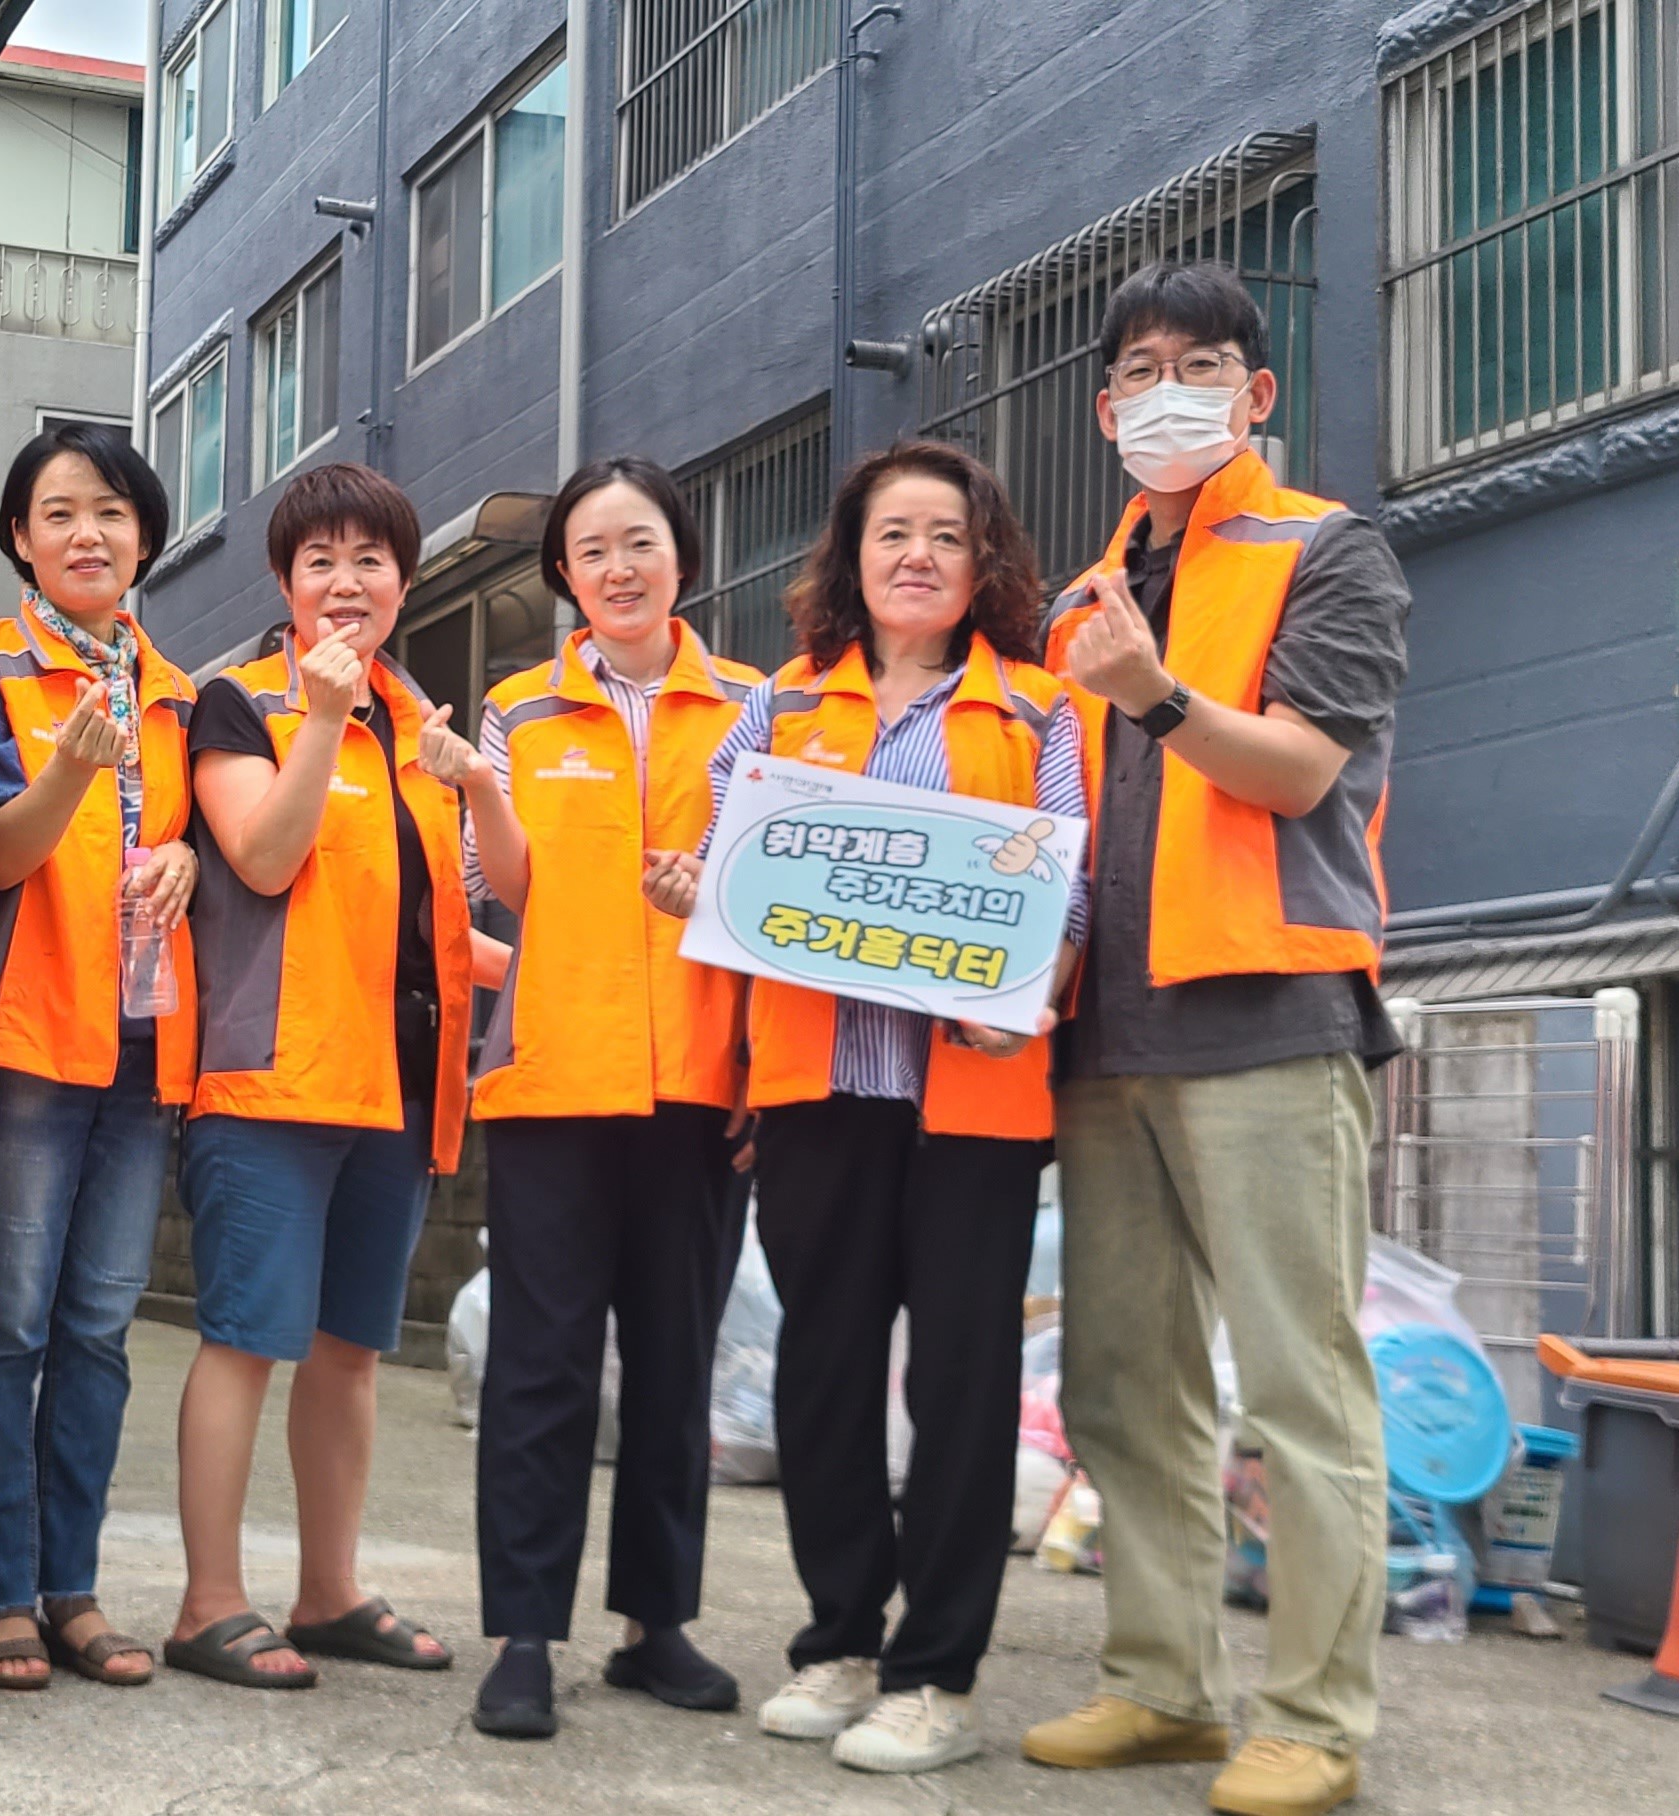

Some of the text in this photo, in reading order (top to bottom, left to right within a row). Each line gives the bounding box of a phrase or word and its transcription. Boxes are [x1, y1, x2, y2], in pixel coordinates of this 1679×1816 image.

[763, 820, 929, 868] 취약계층
[826, 866, 1024, 926] 주거주치의
[760, 904, 1008, 989] 주거홈닥터
